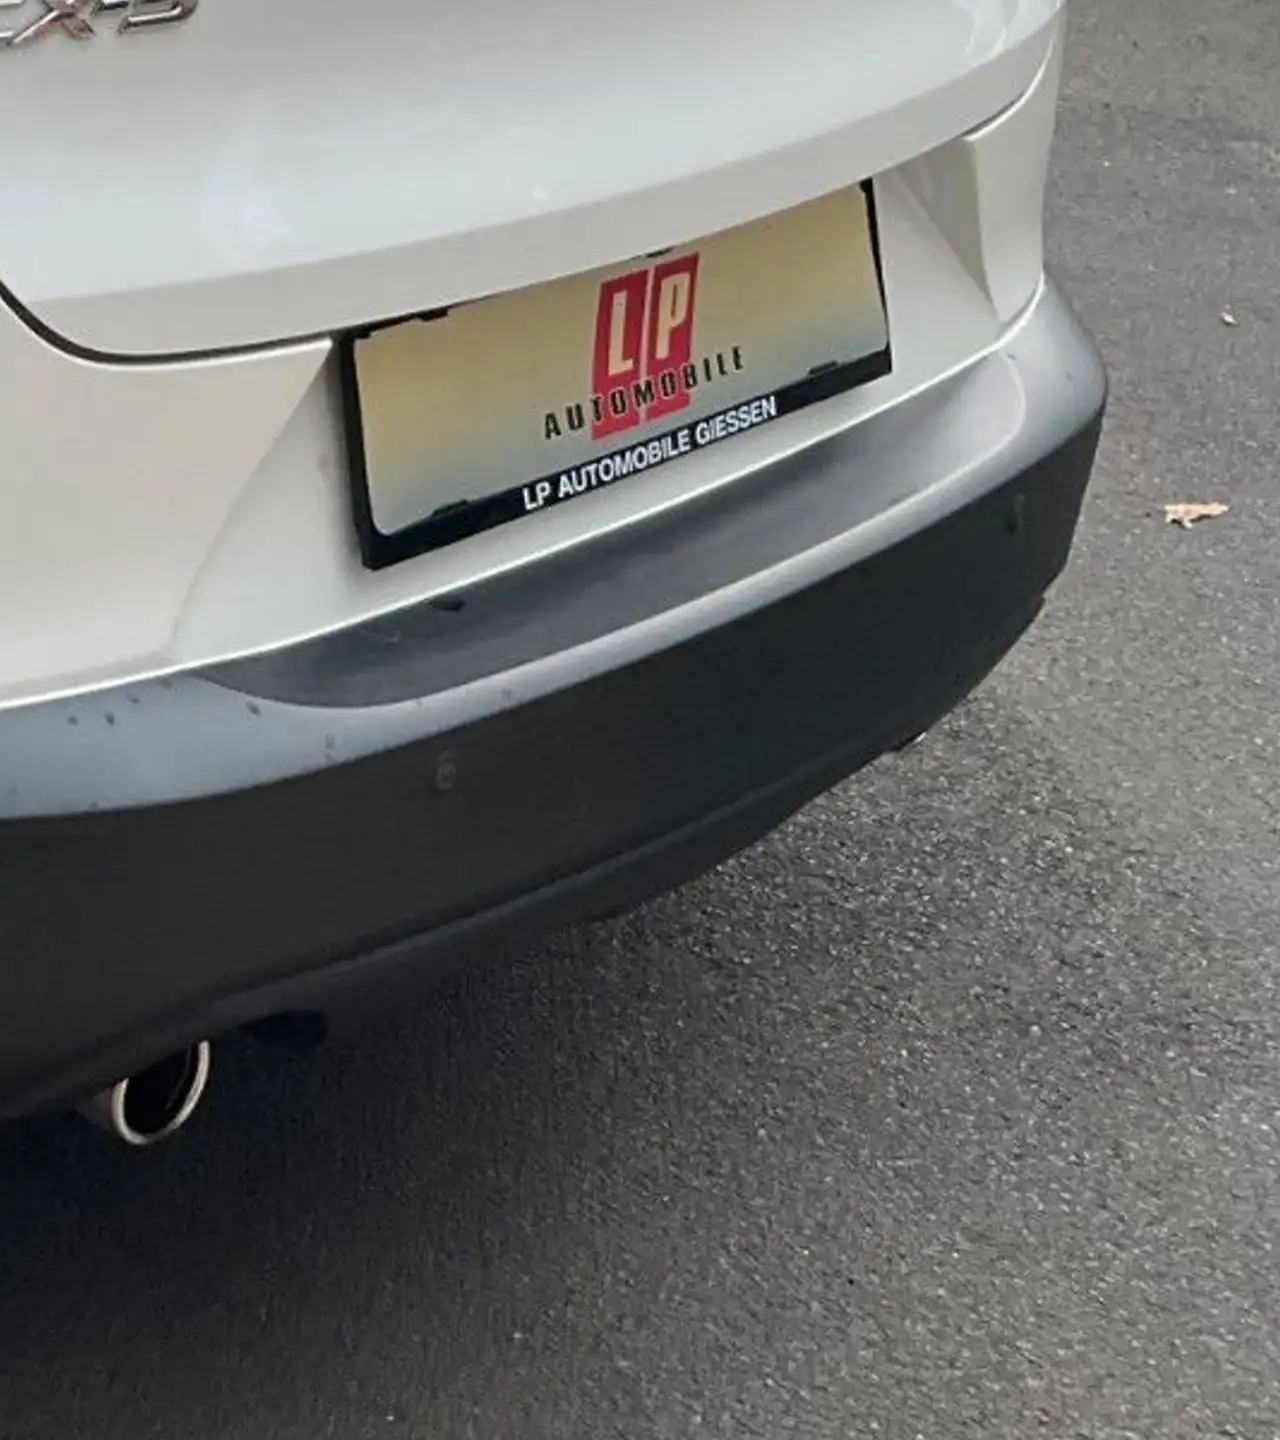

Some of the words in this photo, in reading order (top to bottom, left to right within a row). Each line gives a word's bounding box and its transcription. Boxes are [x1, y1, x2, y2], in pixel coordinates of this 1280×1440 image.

[607, 271, 691, 377] LP
[543, 345, 744, 441] AUTOMOBILE
[522, 481, 552, 510] LP
[557, 429, 691, 499] AUTOMOBILE
[694, 395, 778, 446] GIESSEN
